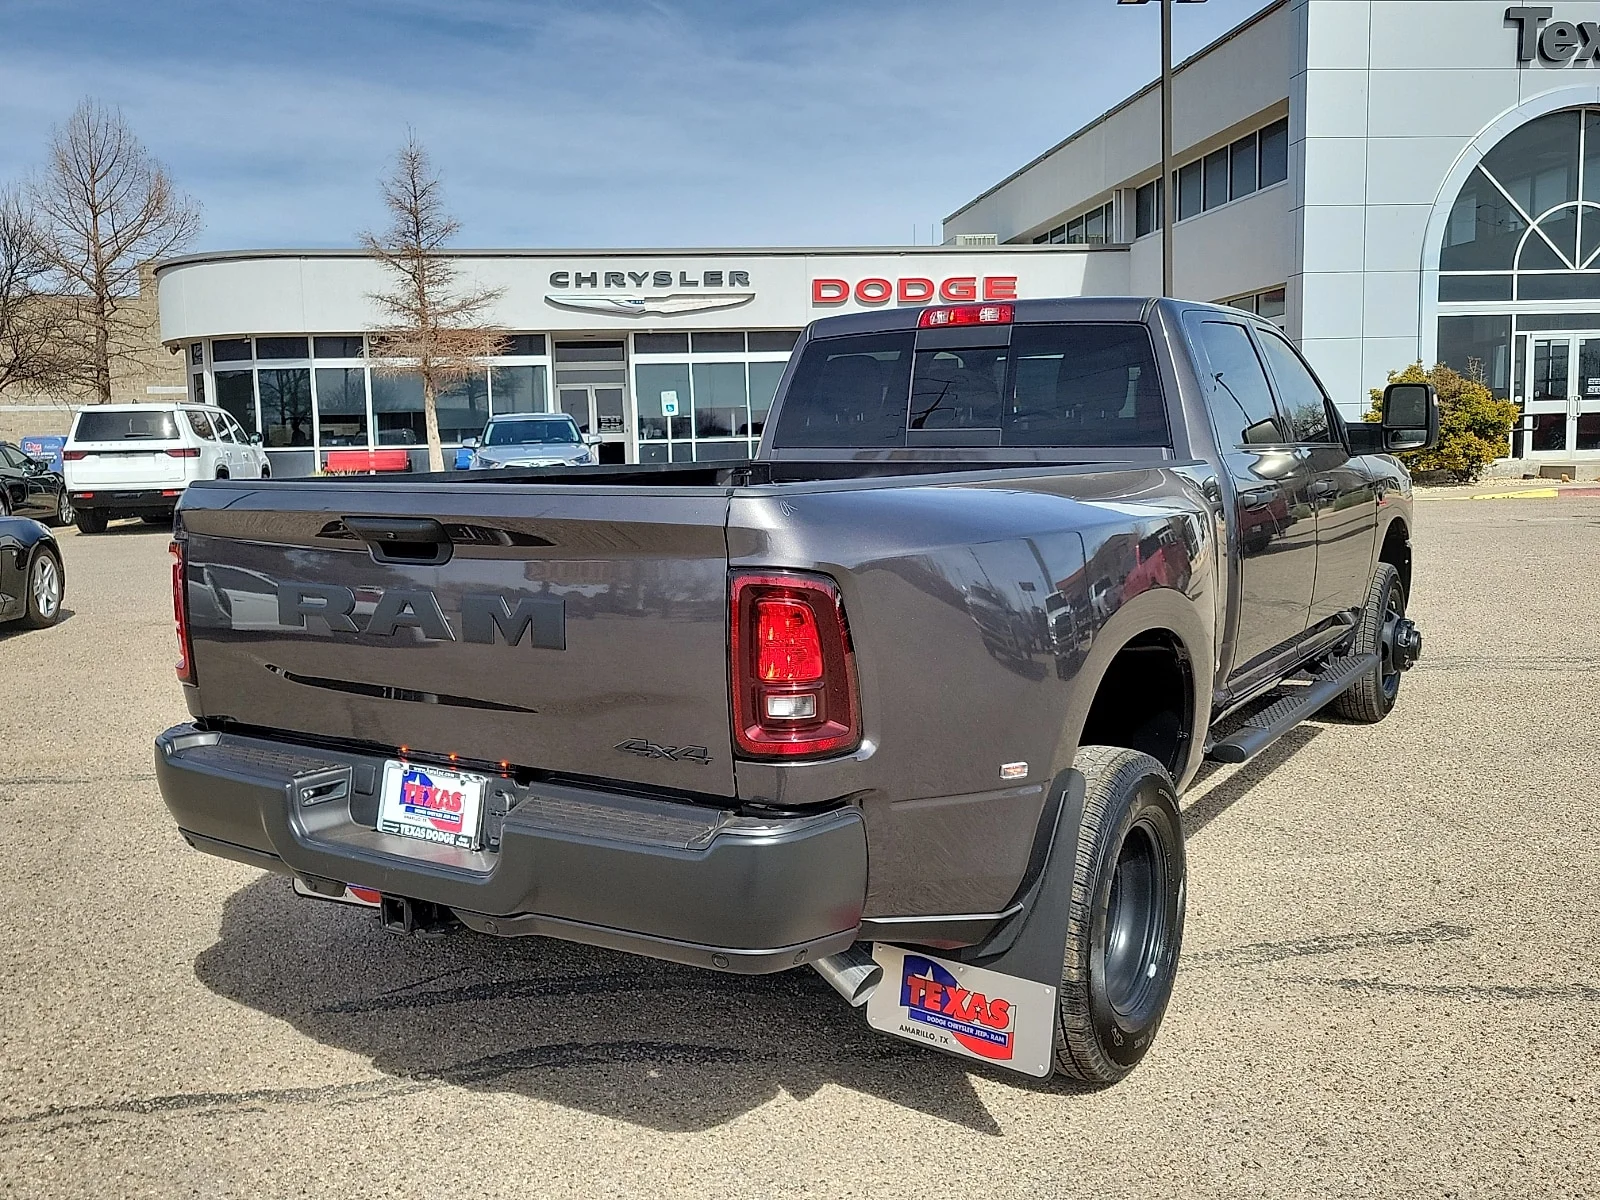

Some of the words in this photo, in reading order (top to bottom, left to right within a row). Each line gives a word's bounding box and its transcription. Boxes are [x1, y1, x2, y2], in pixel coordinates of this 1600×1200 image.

[549, 270, 751, 288] CHRYSLER
[812, 277, 1018, 303] DODGE
[277, 578, 567, 651] RAM
[403, 781, 462, 813] TEXAS
[400, 823, 426, 840] TEXAS
[425, 828, 456, 845] DODGE
[906, 974, 1010, 1030] TEXAS
[898, 1024, 938, 1042] AMARILLO,
[939, 1035, 949, 1045] TX
[926, 1015, 947, 1027] DODGE
[947, 1020, 975, 1034] CHRYSLER
[990, 1033, 1005, 1044] RAM
